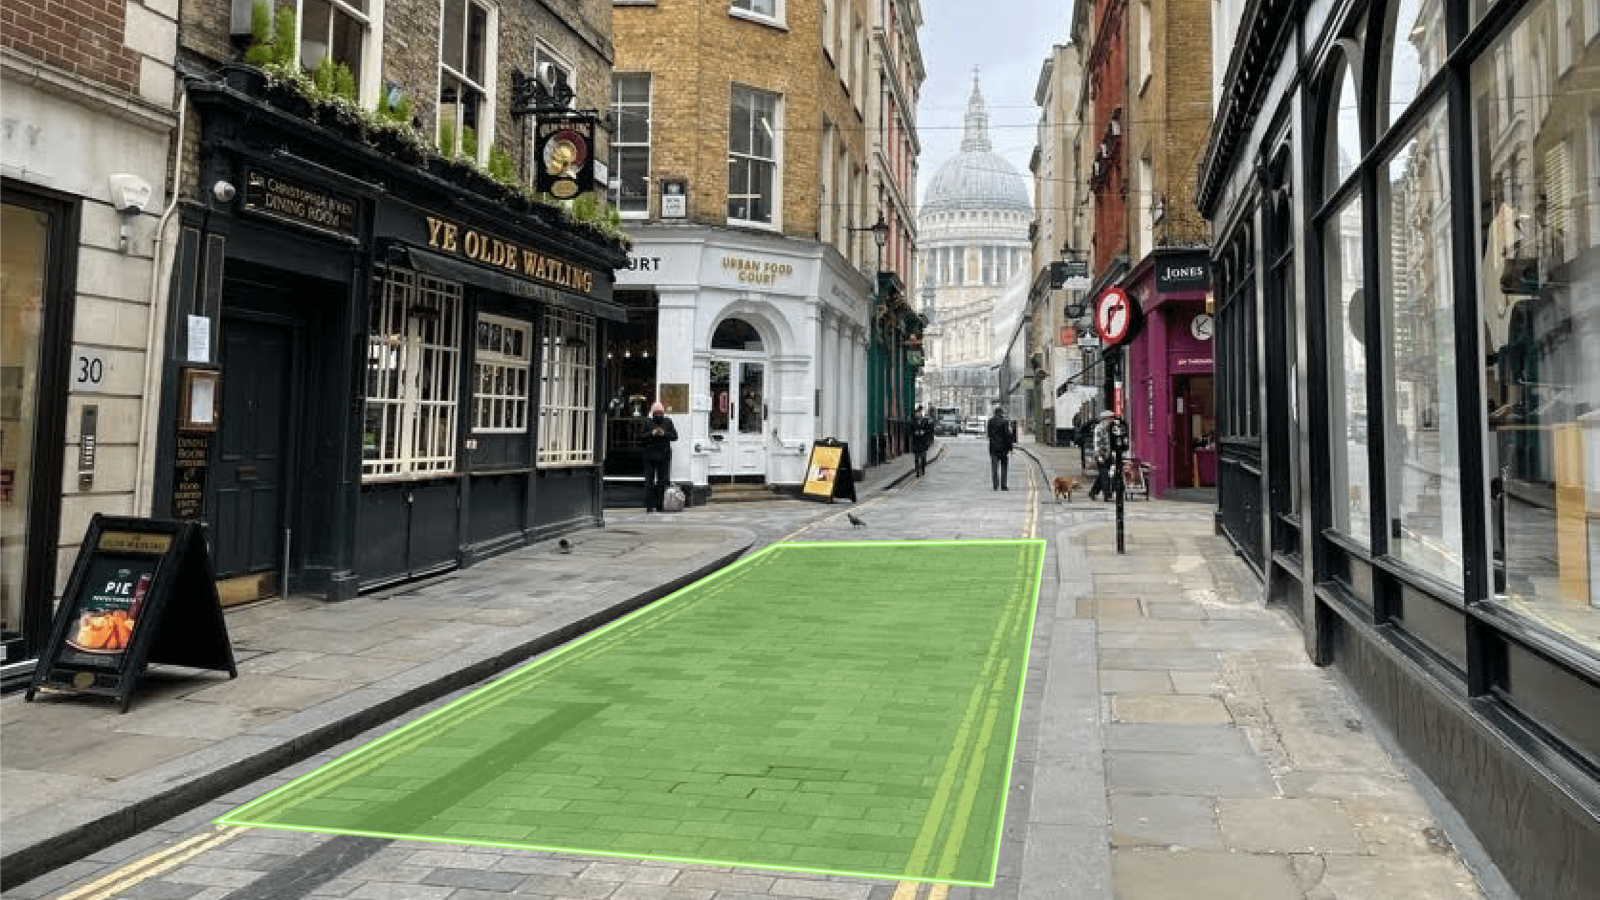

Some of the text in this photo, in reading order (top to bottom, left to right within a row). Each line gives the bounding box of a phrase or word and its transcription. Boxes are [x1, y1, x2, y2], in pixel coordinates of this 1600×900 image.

[307, 205, 340, 227] ROOM
[426, 216, 458, 252] YE
[464, 230, 518, 270] OLDE
[522, 251, 593, 293] WATLING
[722, 256, 794, 275] URBAN FOOD
[1161, 266, 1204, 281] JONES
[738, 271, 776, 285] COURT
[77, 356, 103, 384] 30
[105, 581, 133, 595] PIE
